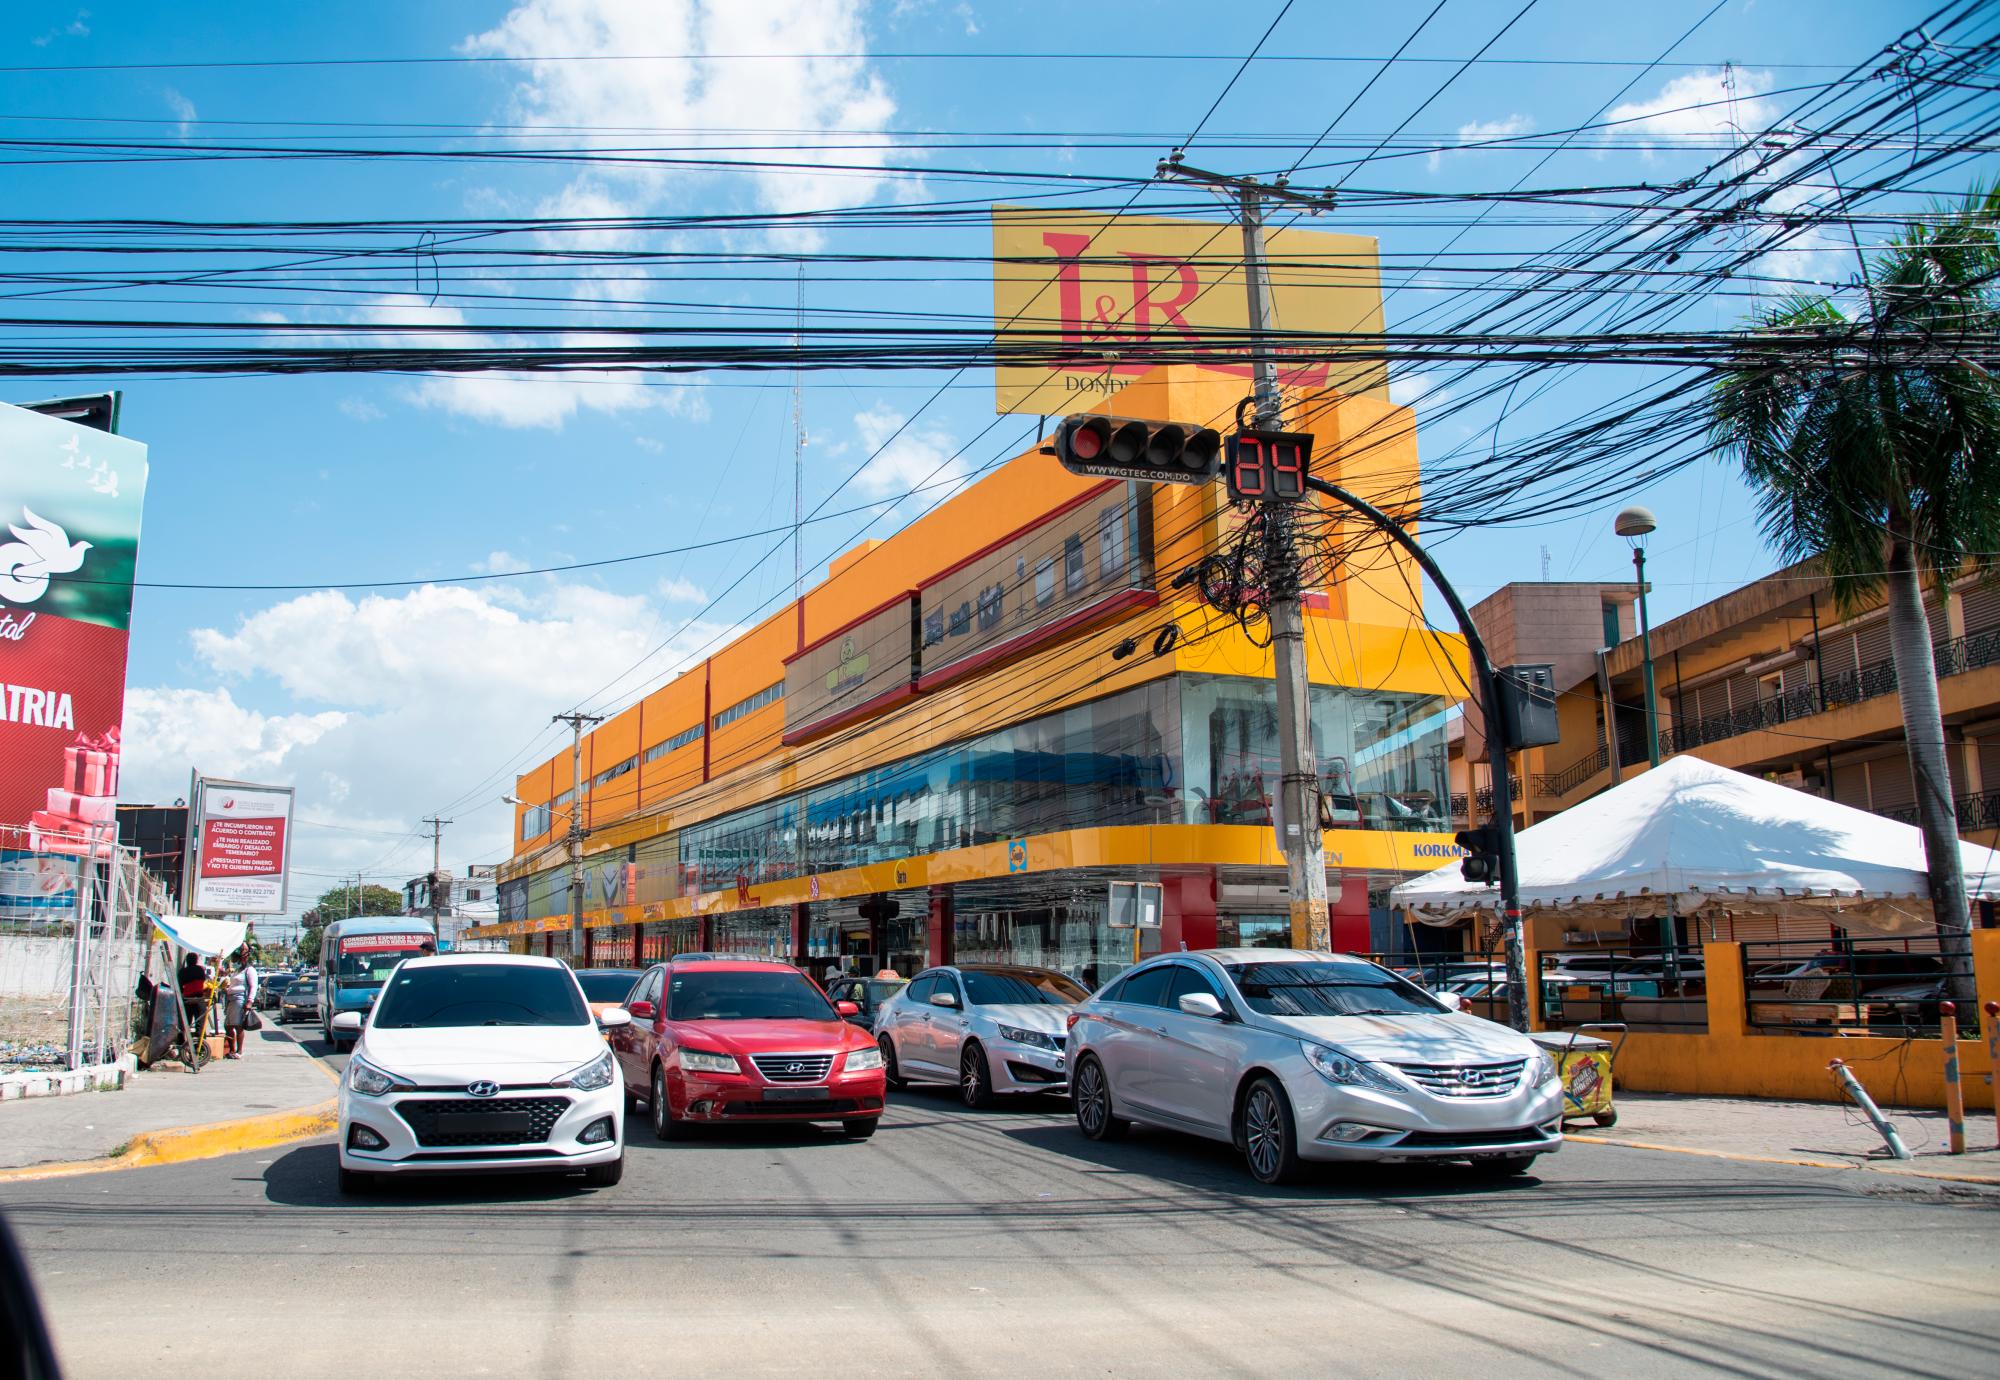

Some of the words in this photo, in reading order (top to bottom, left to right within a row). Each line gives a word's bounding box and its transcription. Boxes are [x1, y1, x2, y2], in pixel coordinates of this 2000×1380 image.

[1086, 464, 1191, 482] WWW.GTEC.COM.DO
[0, 611, 36, 640] tal
[224, 822, 264, 831] INCUMPLIERON
[244, 829, 276, 837] CONTRATO?
[212, 842, 240, 850] EMBARGO
[1413, 843, 1471, 857] KORKMA
